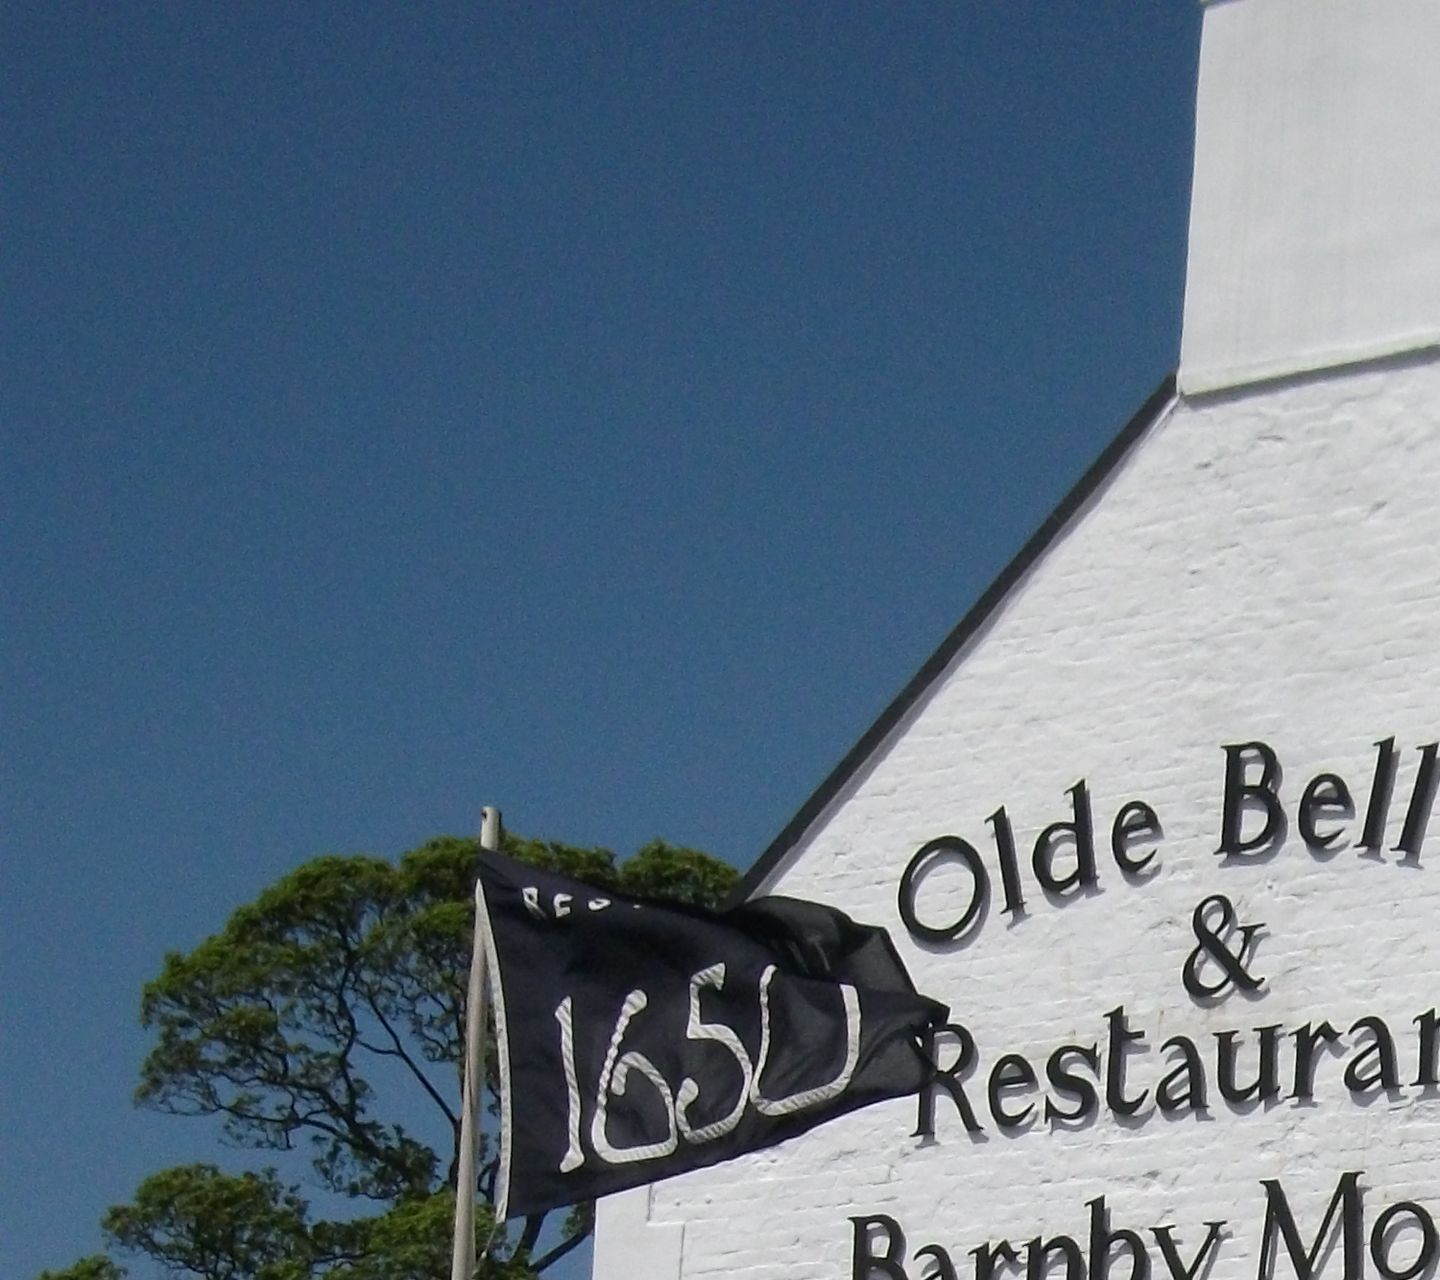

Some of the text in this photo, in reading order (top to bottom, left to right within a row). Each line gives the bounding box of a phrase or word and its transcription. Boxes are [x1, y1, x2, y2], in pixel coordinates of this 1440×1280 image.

[898, 780, 1161, 946] Olde
[1214, 737, 1439, 859] Bell
[1183, 894, 1265, 1000] &
